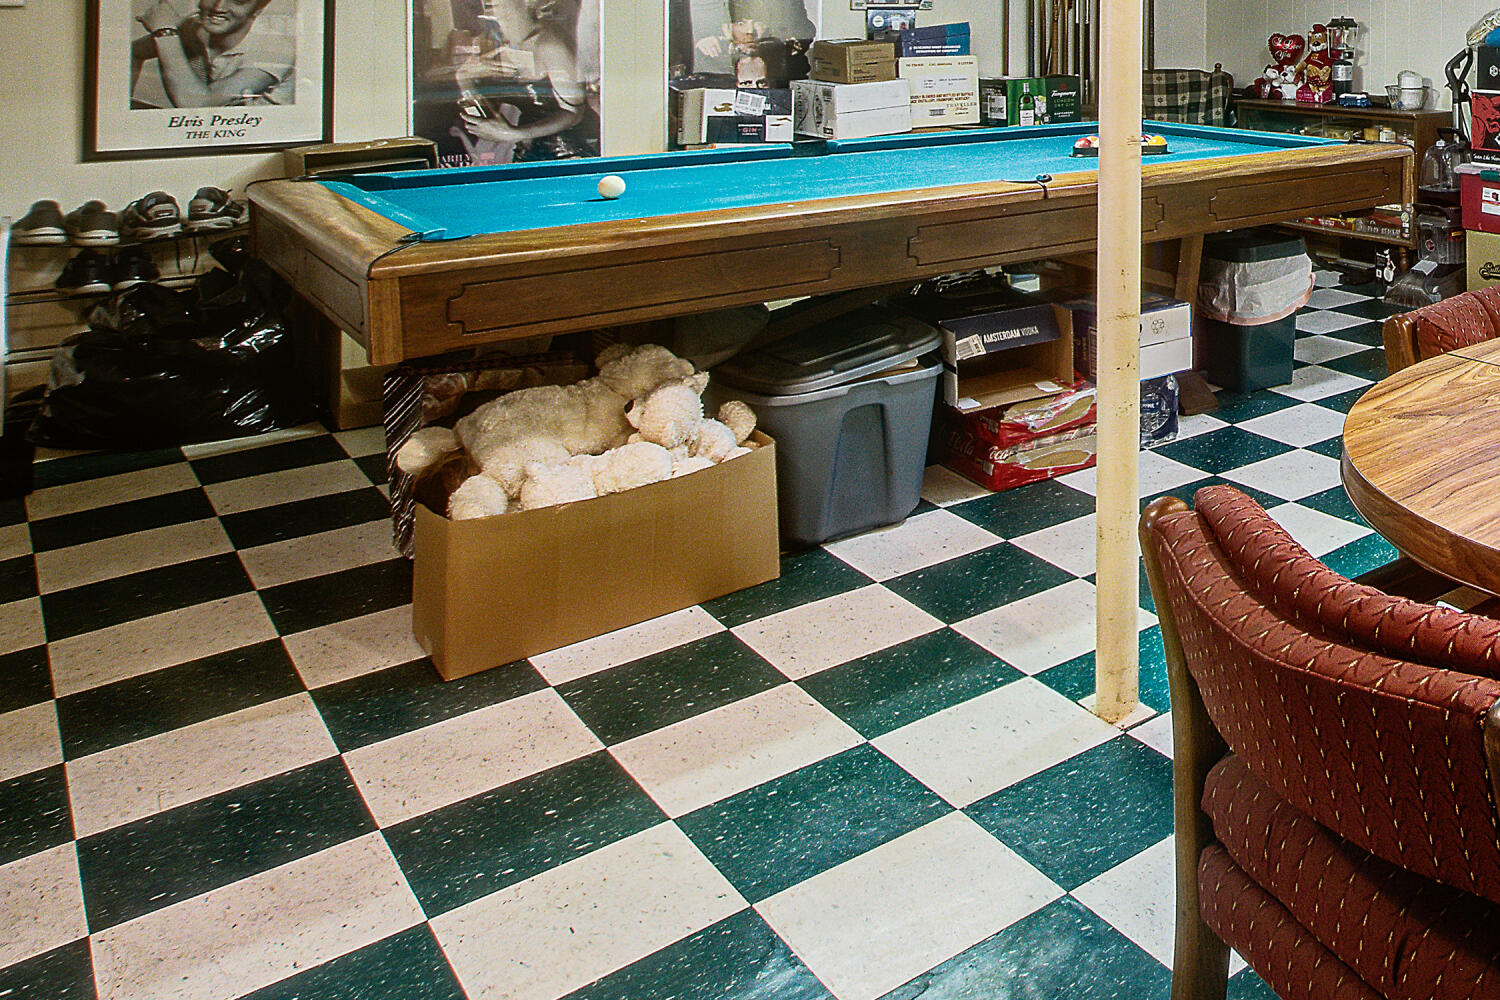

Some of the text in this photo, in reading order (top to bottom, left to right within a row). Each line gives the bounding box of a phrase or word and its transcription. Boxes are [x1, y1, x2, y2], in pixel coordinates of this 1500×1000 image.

[168, 113, 263, 128] Elvis Presley
[186, 129, 246, 139] THE KING
[983, 325, 1040, 344] AMSTERDAM VODKA
